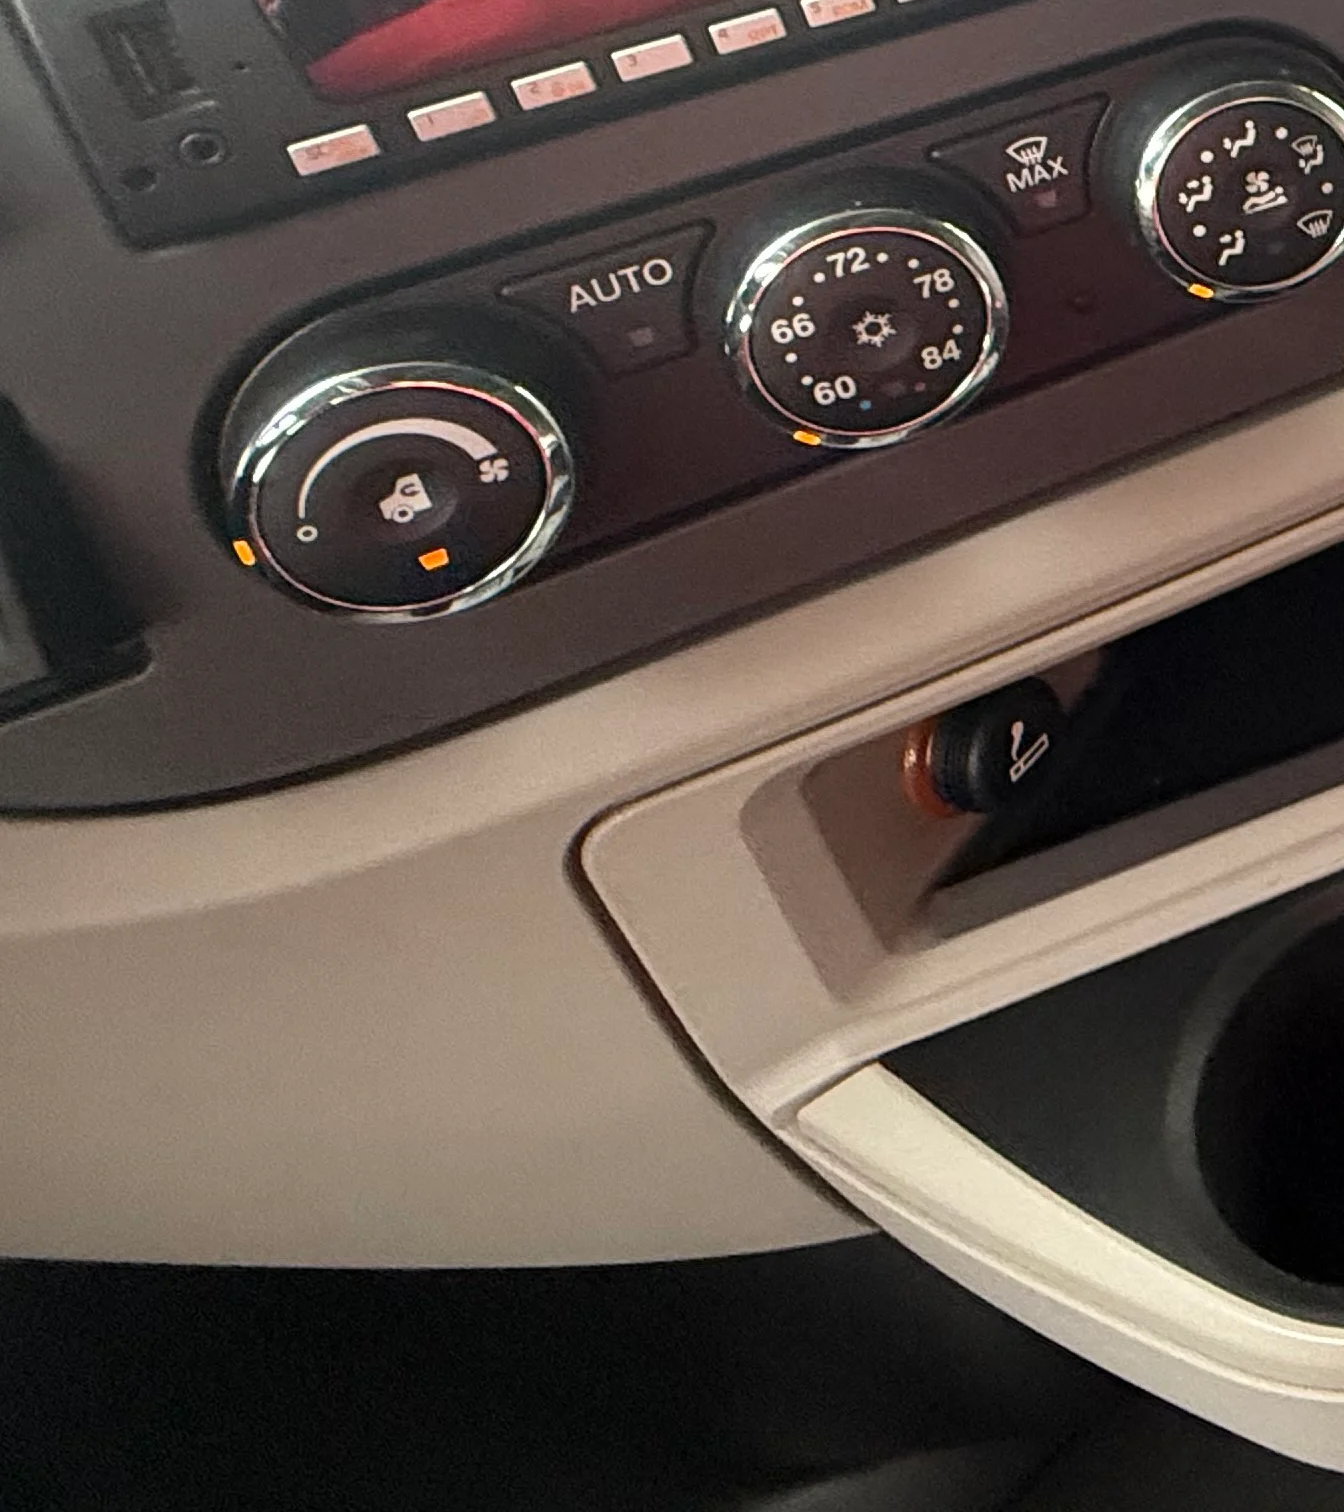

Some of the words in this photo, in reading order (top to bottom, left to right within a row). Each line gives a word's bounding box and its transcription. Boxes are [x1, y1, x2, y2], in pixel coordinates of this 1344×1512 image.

[1005, 155, 1069, 193] MAX
[826, 246, 871, 280] 72
[568, 257, 673, 315] AUTO
[913, 268, 956, 300] 78
[770, 311, 816, 345] 66
[920, 338, 961, 371] 84
[812, 375, 857, 407] 60
